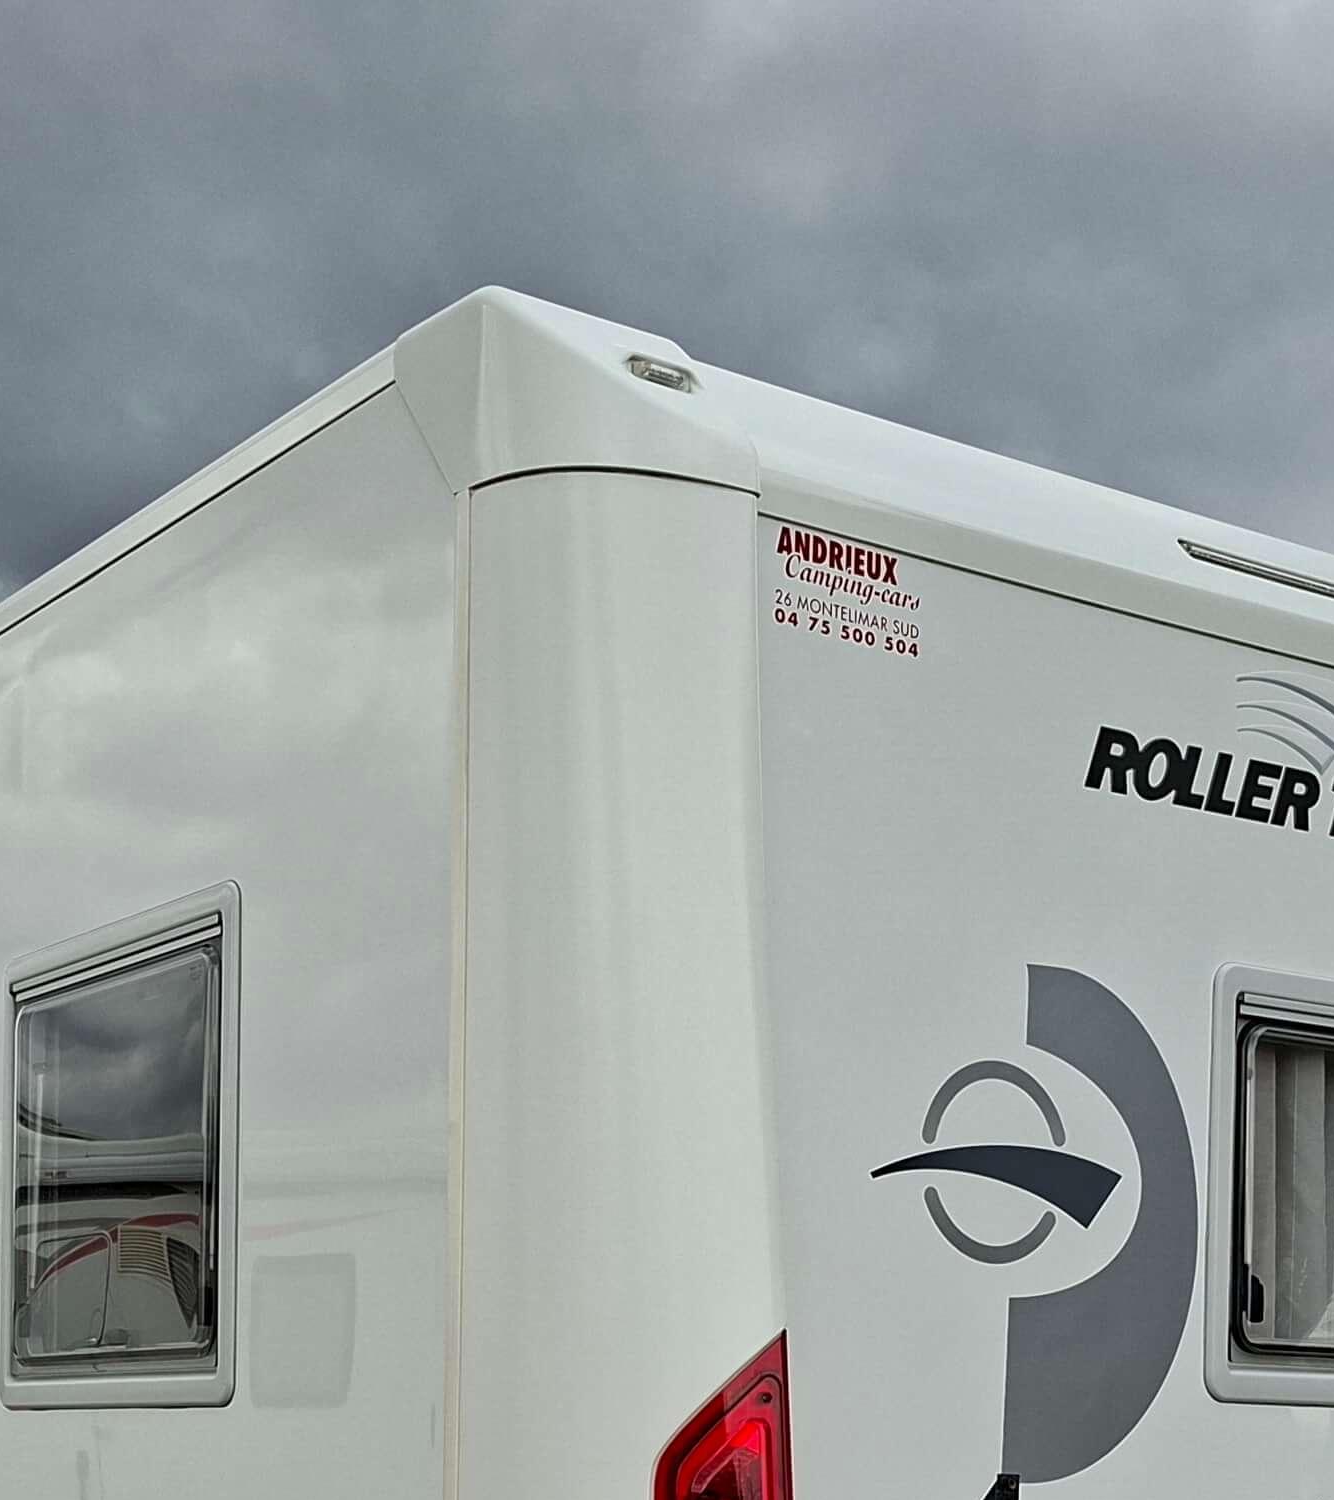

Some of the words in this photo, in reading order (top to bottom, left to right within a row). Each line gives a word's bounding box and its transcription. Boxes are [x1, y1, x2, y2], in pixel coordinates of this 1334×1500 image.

[776, 526, 898, 586] ANDRIEUX
[785, 554, 921, 610] Camping-cars
[774, 608, 799, 628] 04
[808, 616, 831, 635] 75
[840, 625, 876, 646] 500
[884, 637, 919, 658] 504
[775, 589, 792, 607] 26
[796, 595, 888, 632] MONTELIMAR
[893, 619, 920, 639] SUD
[1083, 725, 1322, 833] ROLLER
